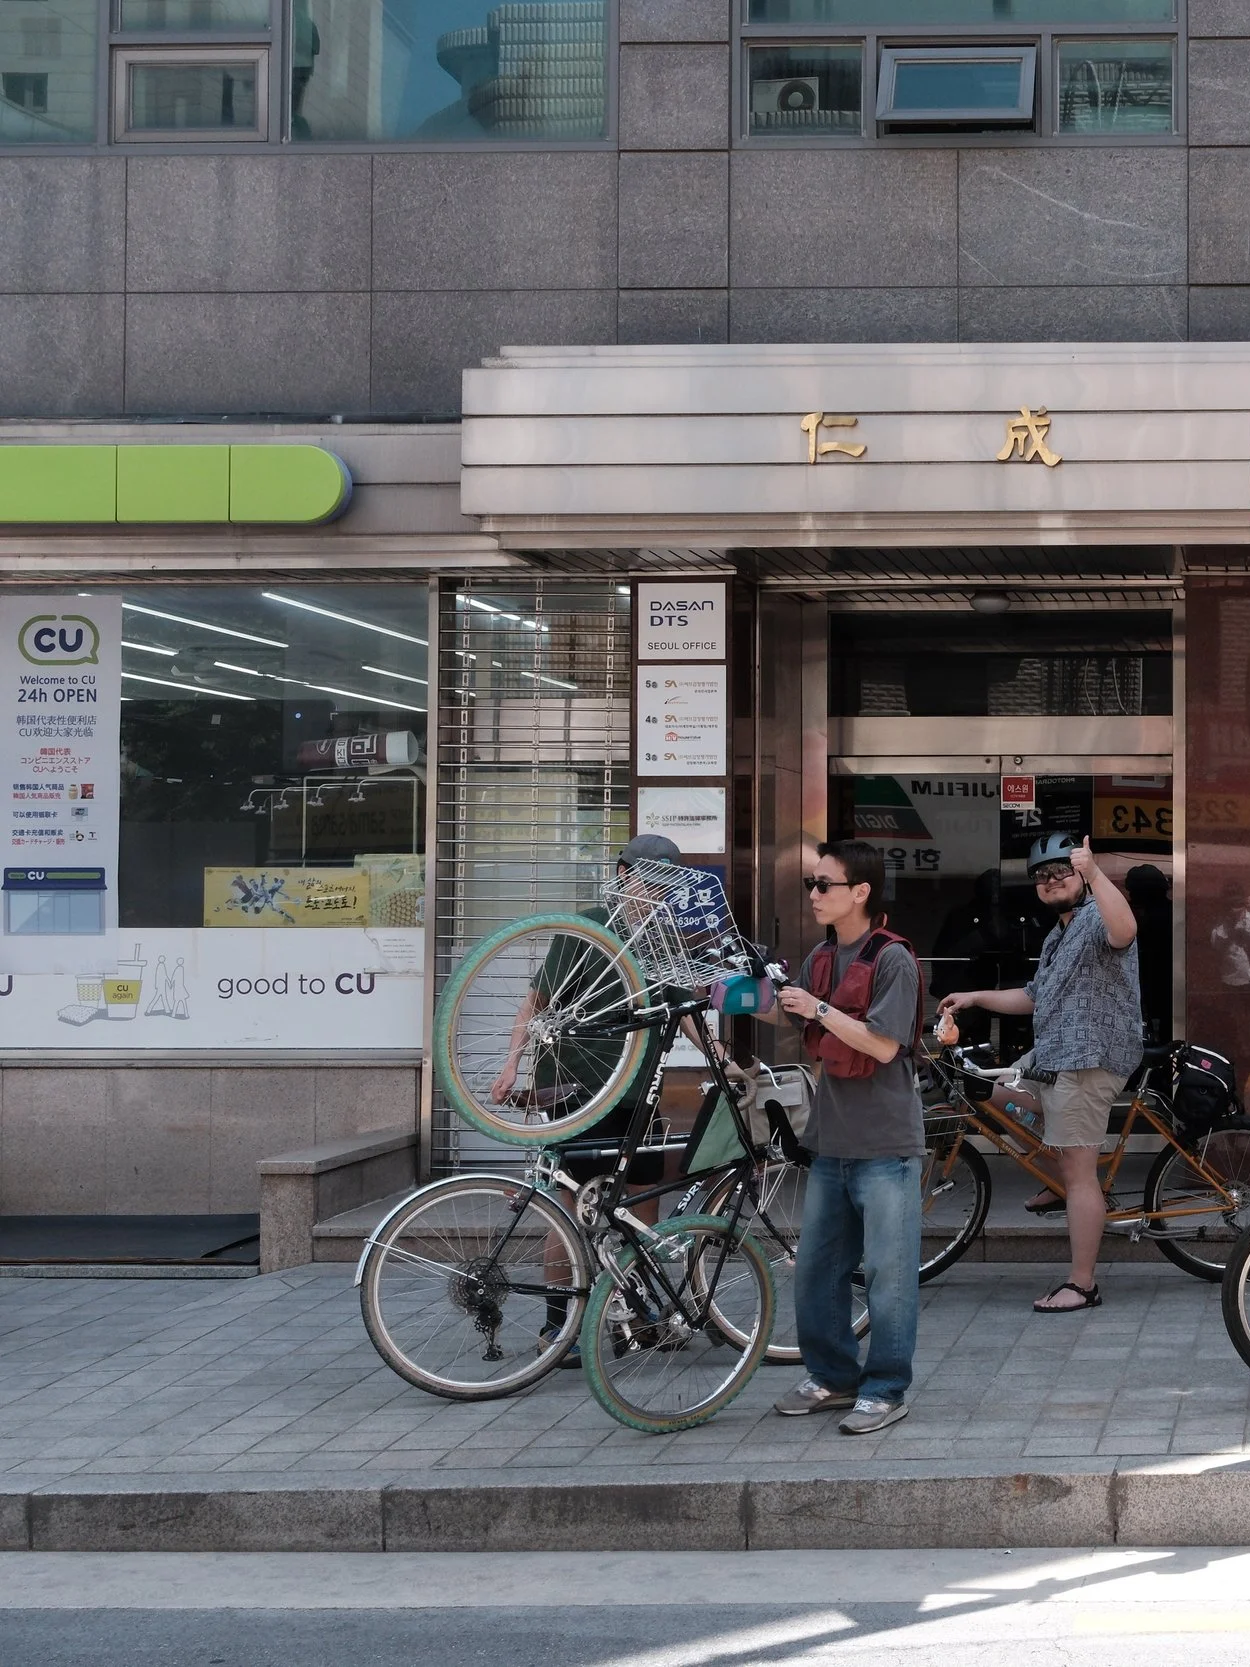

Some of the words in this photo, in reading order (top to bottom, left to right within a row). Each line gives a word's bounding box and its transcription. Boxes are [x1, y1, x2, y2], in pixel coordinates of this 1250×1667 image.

[650, 601, 714, 611] DASAN
[650, 615, 689, 627] DTS
[33, 627, 84, 653] CU
[647, 642, 680, 650] SEOUL
[682, 642, 717, 650] OFFICE
[20, 675, 65, 685] Welcome
[68, 676, 79, 685] to
[81, 675, 96, 685] CU
[18, 688, 48, 703] 24h
[53, 688, 97, 703] OPEN
[27, 871, 45, 881] CU
[116, 984, 130, 992] CU
[217, 972, 289, 999] good
[298, 973, 326, 995] to
[335, 972, 376, 995] CU
[112, 992, 133, 1000] again
